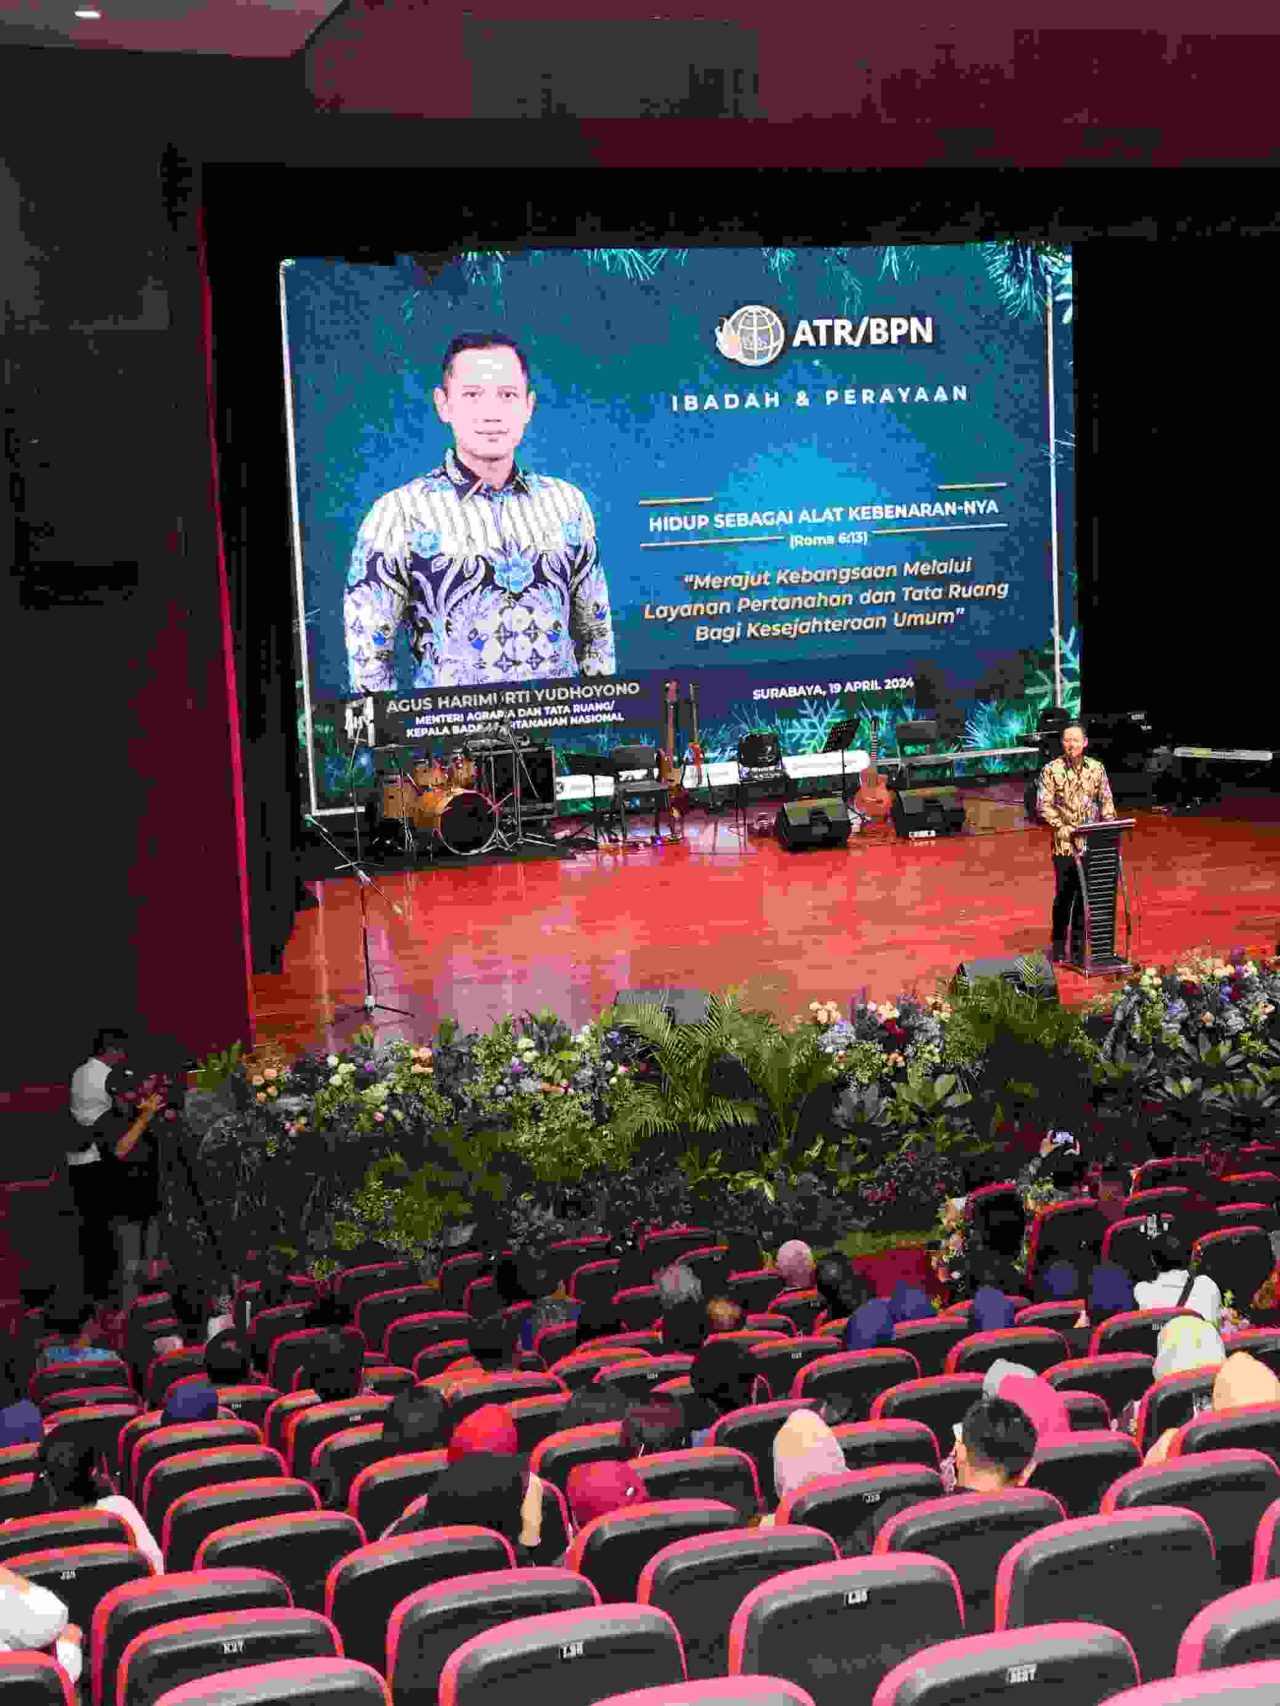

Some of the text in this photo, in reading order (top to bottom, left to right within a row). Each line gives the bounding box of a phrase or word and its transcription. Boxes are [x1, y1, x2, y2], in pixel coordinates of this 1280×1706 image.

[792, 316, 933, 347] ATR/BPN
[671, 385, 969, 412] IBADAH & PERAYAAN
[649, 499, 999, 533] HIDUP SEBAGAI ALAT KEBENARAN-NYA
[790, 531, 868, 550] (Roma 6:13)
[776, 565, 897, 584] Kebangsaan
[903, 557, 972, 577] Melalui
[644, 582, 1009, 622] Layanan Pertanahan dan Tata Ruang
[695, 622, 741, 643] Bagi
[747, 614, 886, 638] Kesejahteraan
[387, 697, 432, 713] AGUS
[535, 682, 640, 701] YUDHOYONO
[753, 677, 914, 700] SURABAYA, 19 APRIL 2024
[406, 725, 450, 738] KEPALA
[570, 712, 624, 725] NASIONAL
[416, 713, 464, 725] MENTERI
[518, 707, 541, 718] DAN
[543, 704, 571, 716] TATA
[572, 700, 615, 713] RUANG/
